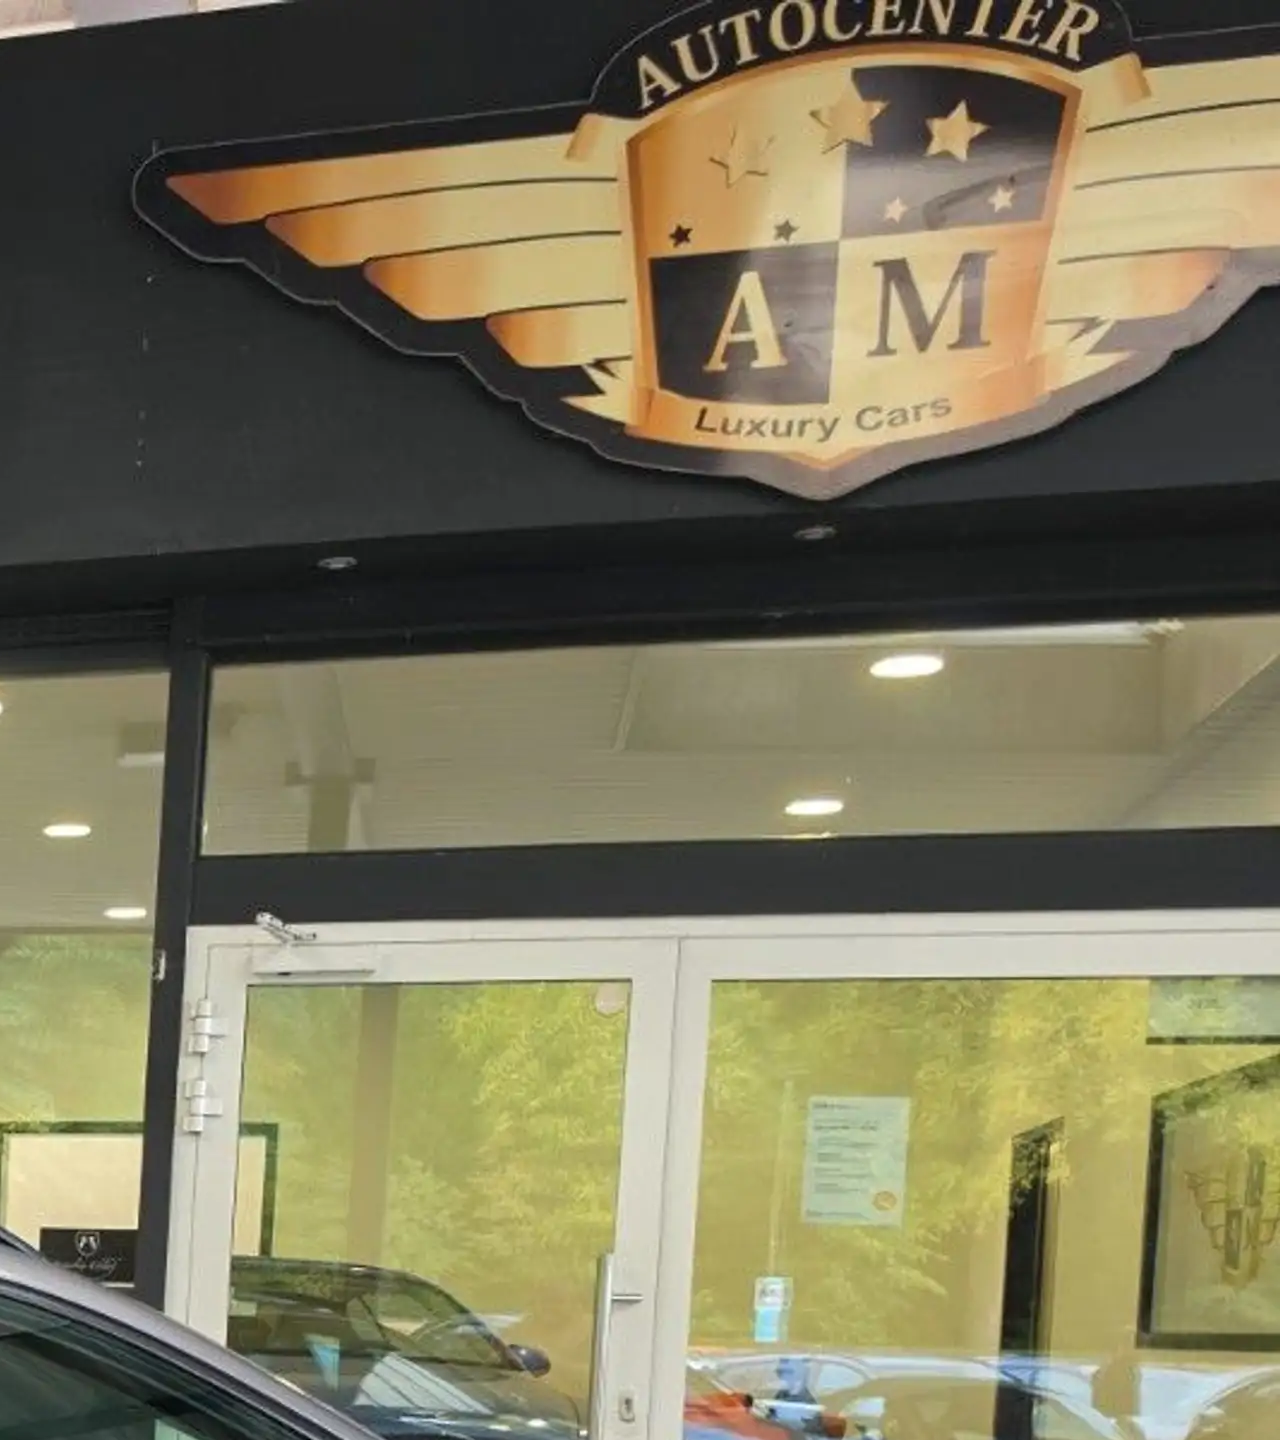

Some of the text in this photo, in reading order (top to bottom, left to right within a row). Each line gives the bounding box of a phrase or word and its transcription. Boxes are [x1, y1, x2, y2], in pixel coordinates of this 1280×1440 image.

[636, 0, 1102, 109] AUTOCENTER
[701, 249, 998, 373] A M
[693, 397, 953, 444] Luxury Cars
